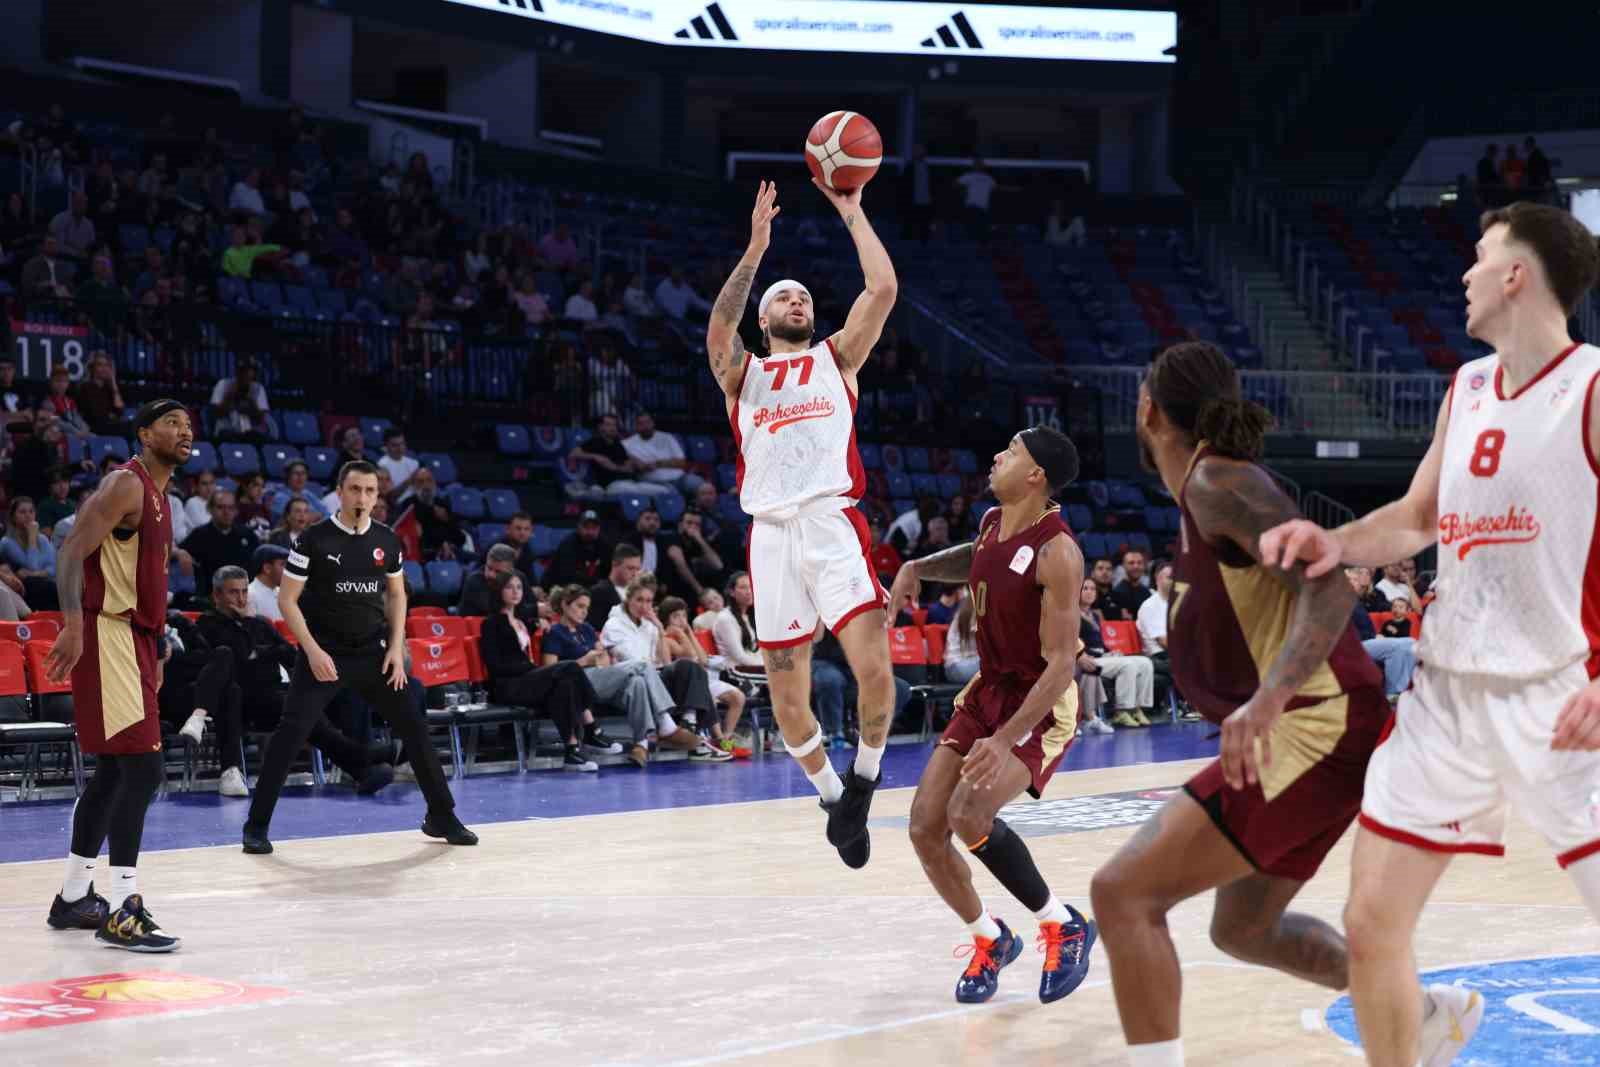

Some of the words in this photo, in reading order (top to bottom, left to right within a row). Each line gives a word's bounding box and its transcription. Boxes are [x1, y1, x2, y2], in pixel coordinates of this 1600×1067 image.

[16, 335, 84, 382] 118
[763, 355, 815, 391] 77
[1469, 428, 1506, 478] 8
